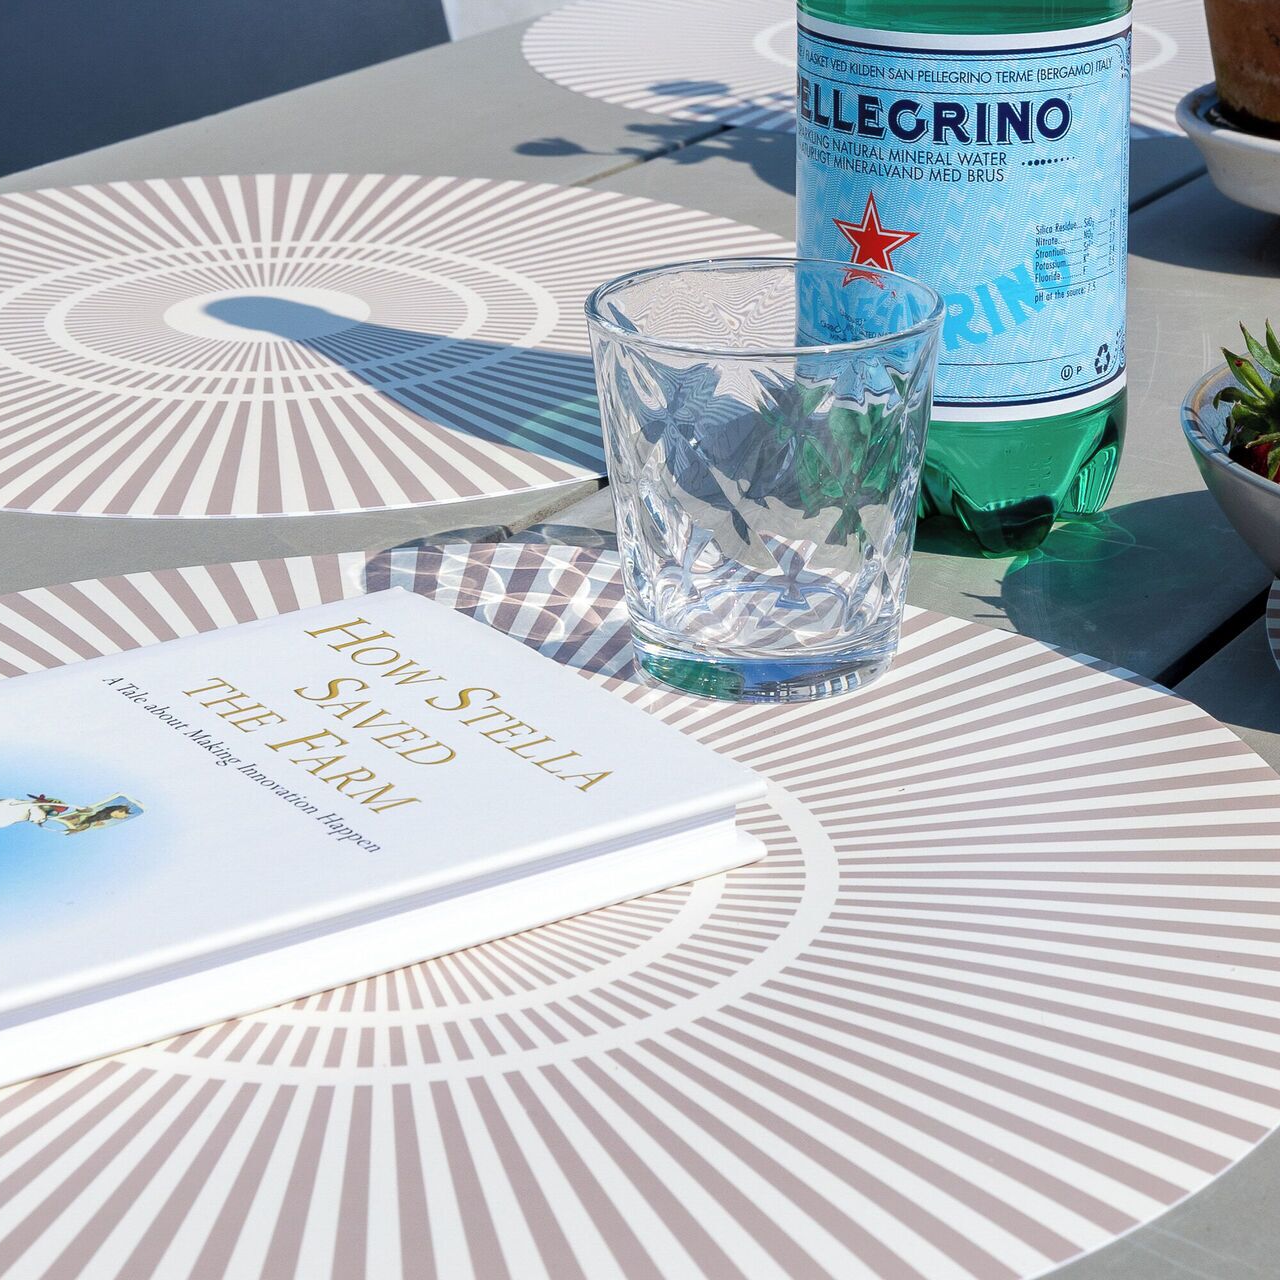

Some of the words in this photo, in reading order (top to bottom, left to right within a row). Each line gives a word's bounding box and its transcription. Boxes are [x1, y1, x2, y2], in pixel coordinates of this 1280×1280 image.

[830, 57, 847, 72] VED
[850, 63, 885, 79] KILDEN
[888, 69, 914, 82] SAN
[917, 71, 992, 84] PELLEGRINO
[995, 70, 1033, 84] TERME
[1036, 62, 1094, 82] (BERGAMO)
[1096, 57, 1113, 72] ITALY
[797, 72, 1072, 145] ELLEGRINO
[832, 138, 884, 160] NATURAL
[888, 150, 952, 166] MINERAL
[957, 152, 1008, 166] WATER
[833, 155, 924, 180] MINERALVAND
[928, 169, 962, 182] MED
[967, 168, 1004, 182] BRUS
[1036, 225, 1052, 235] Silica
[1036, 237, 1058, 247] Nitrate
[1036, 248, 1066, 259] Strontium
[1036, 260, 1066, 270] Potassium
[1035, 272, 1060, 282] Fluoride
[1034, 292, 1044, 304] pH
[1054, 290, 1064, 298] the
[304, 616, 448, 691] HOW
[424, 686, 616, 793] STELLA
[293, 676, 458, 766] SAVED
[182, 676, 287, 734] THE
[264, 728, 423, 815] FARM
[102, 677, 124, 686] A
[116, 683, 149, 704] Tale
[144, 704, 190, 730] about
[182, 729, 242, 767] Making
[237, 763, 318, 815] Innovation
[316, 812, 382, 853] Happen
